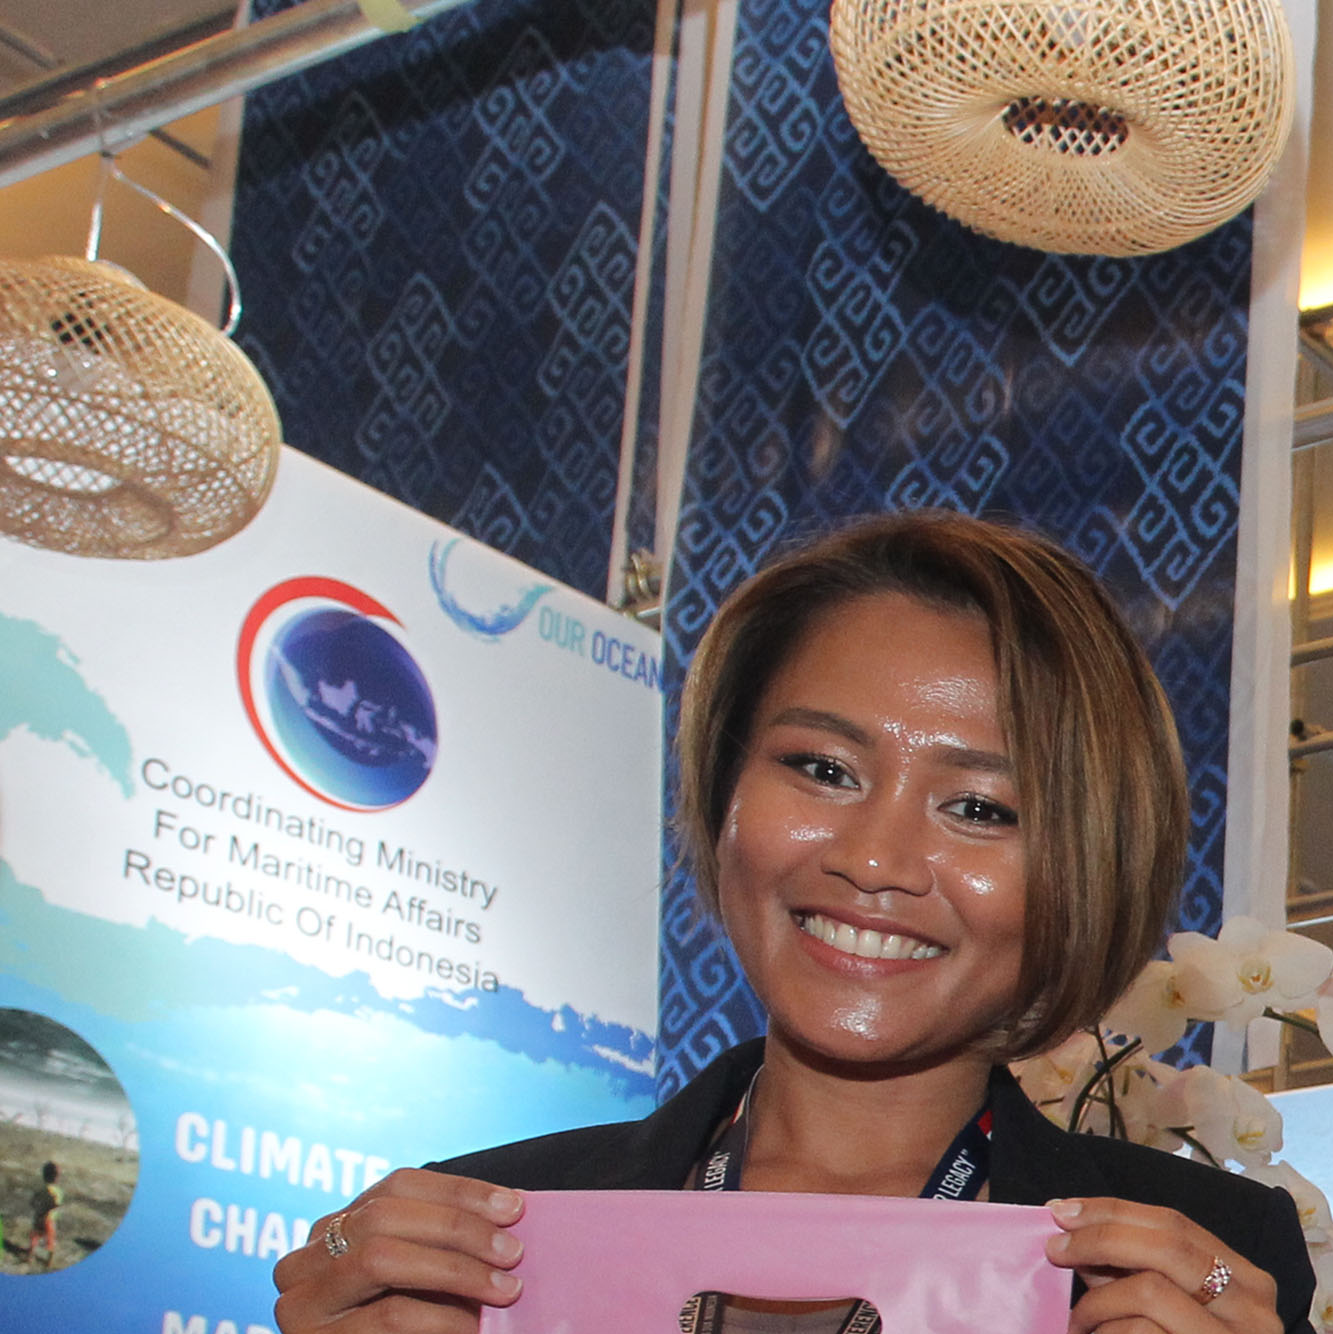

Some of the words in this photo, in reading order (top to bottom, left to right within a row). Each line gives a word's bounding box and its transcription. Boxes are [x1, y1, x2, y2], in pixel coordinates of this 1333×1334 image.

[538, 605, 586, 656] OUR
[141, 757, 364, 865] Coordinating
[376, 840, 498, 909] Ministry
[154, 810, 217, 857] For
[228, 835, 373, 908] Maritime
[382, 891, 482, 944] Affairs
[123, 849, 284, 925] Republic
[296, 907, 336, 942] Of
[346, 922, 500, 993] Indonesia
[175, 1110, 391, 1198] CLIMATE
[937, 1148, 976, 1197] LEGACY"
